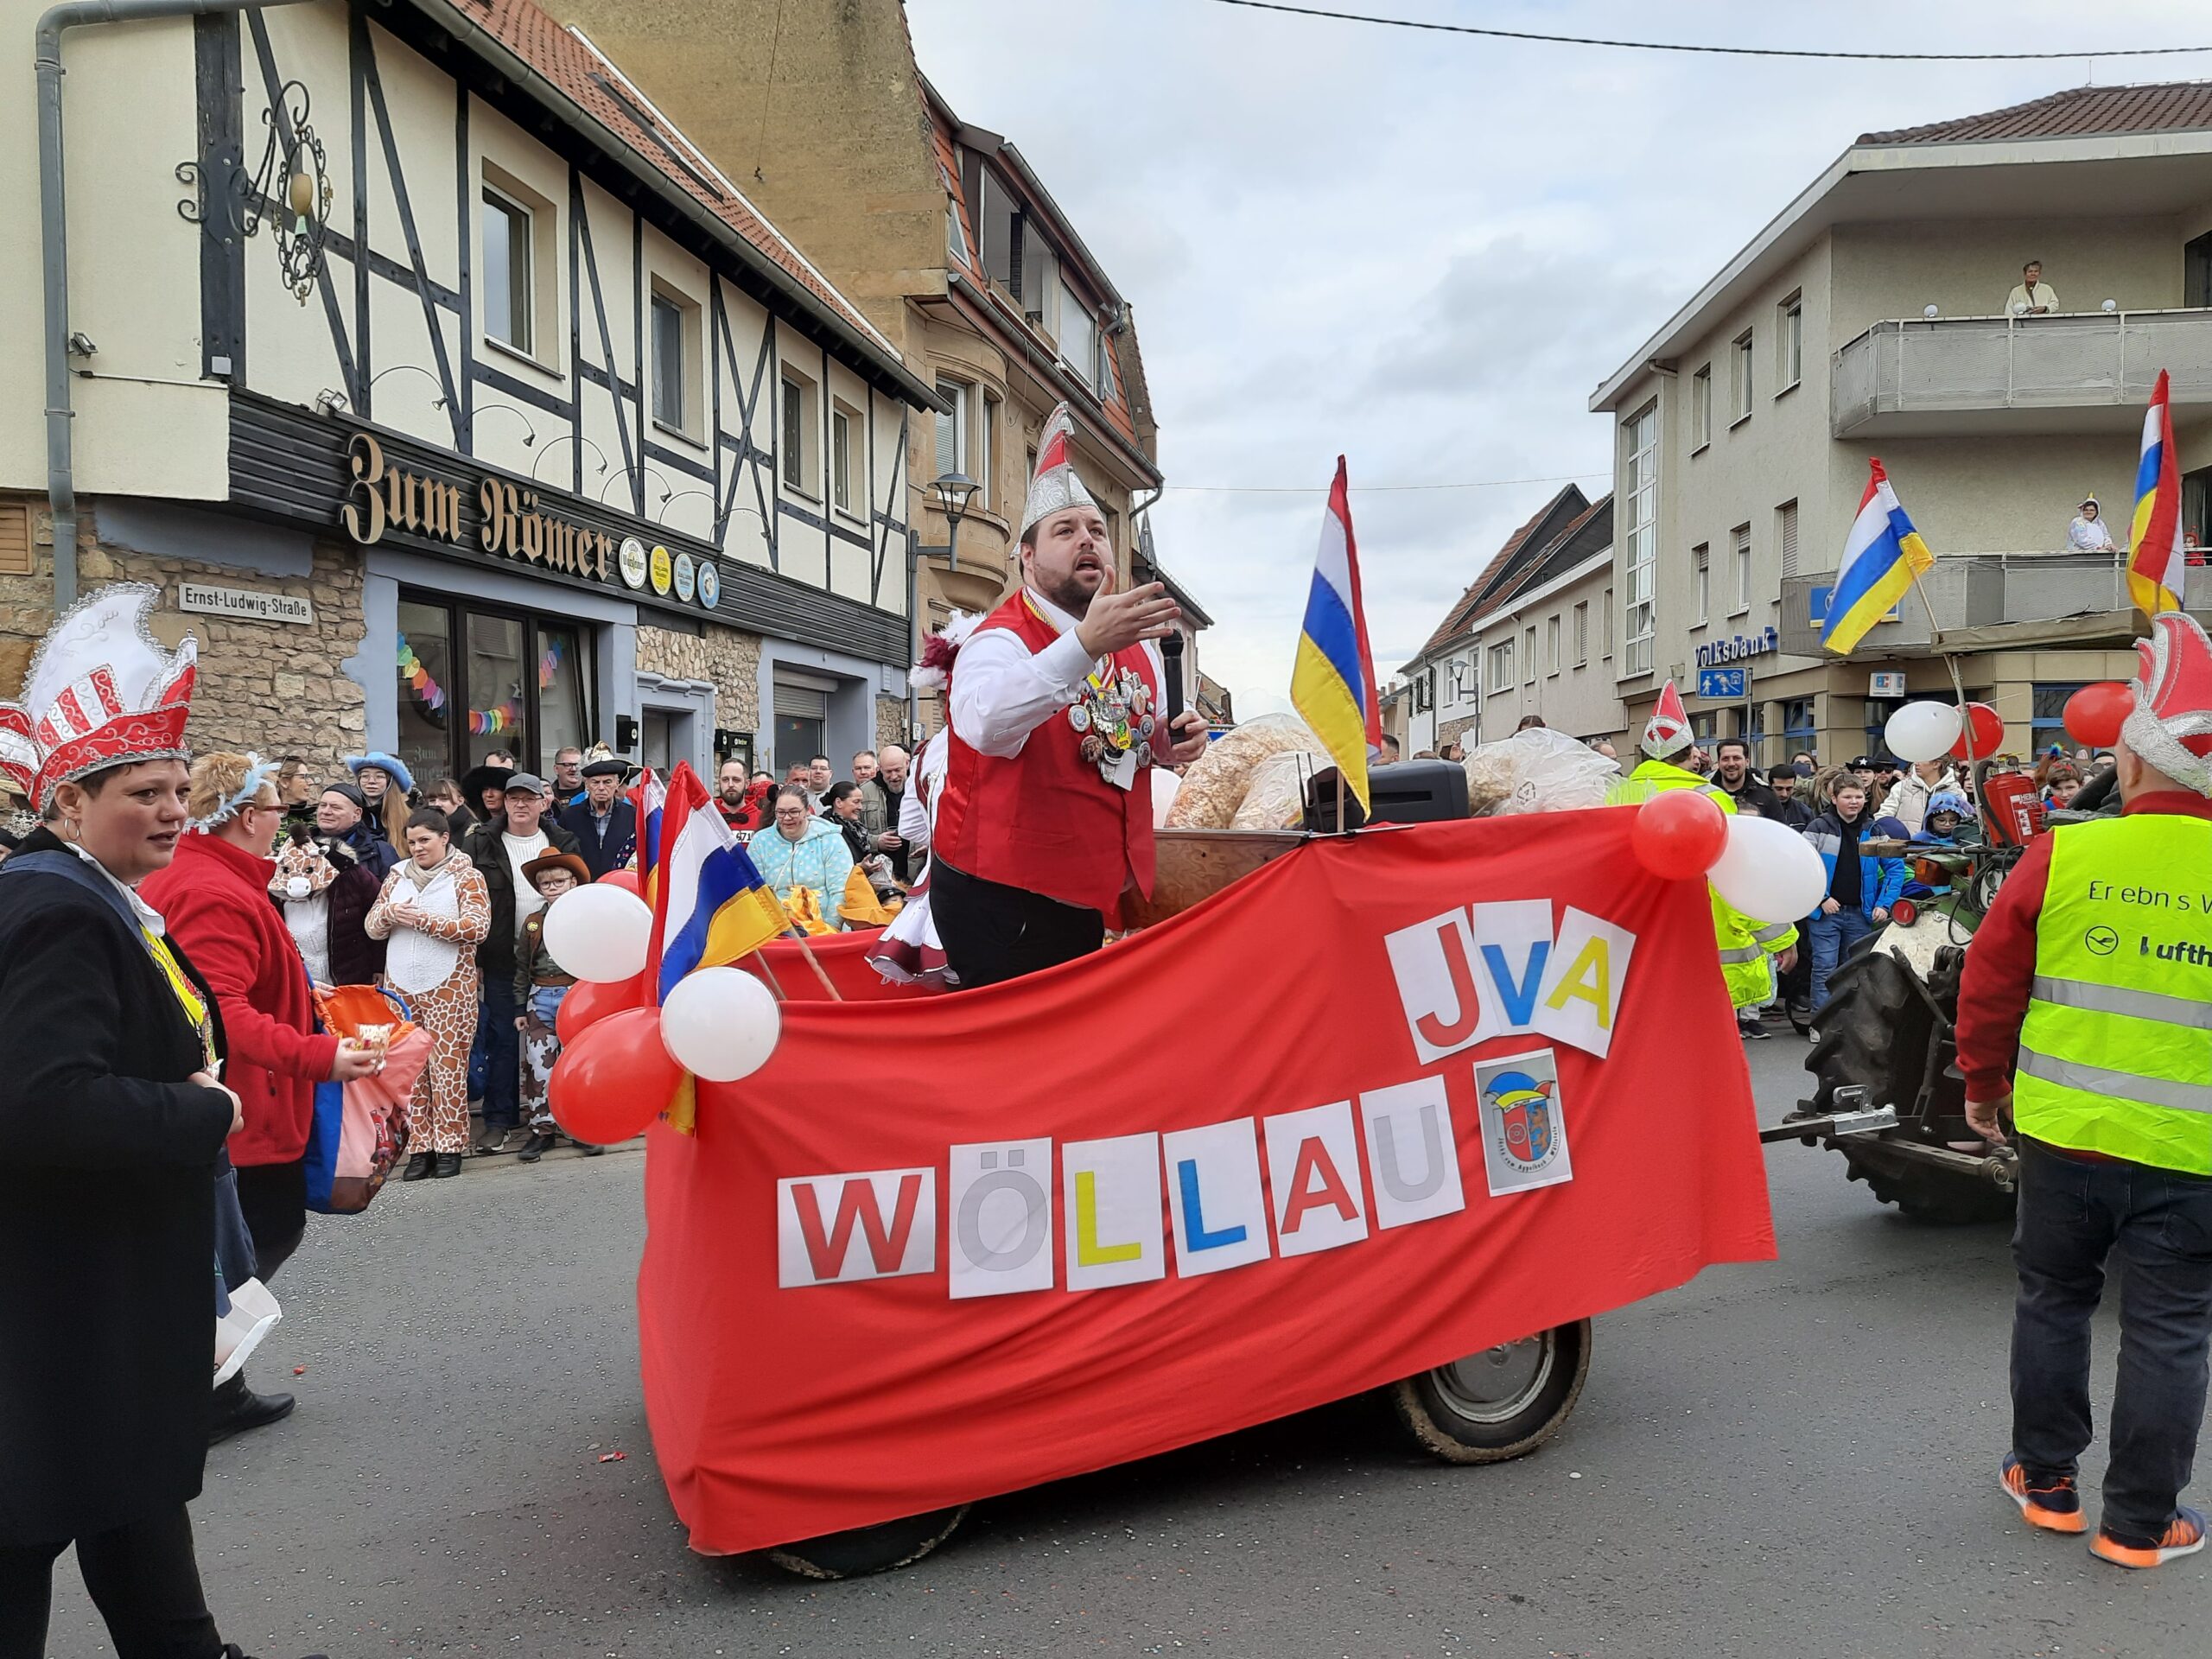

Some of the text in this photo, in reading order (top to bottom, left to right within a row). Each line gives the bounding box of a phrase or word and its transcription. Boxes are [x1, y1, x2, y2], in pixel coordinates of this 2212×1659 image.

[340, 433, 613, 582] Zum Römer
[186, 588, 307, 616] Ernst-Ludwig-Straße
[1694, 626, 1778, 667] Volksbank
[1415, 926, 1611, 1047] JVA
[790, 1105, 1446, 1280] WÖLLAU
